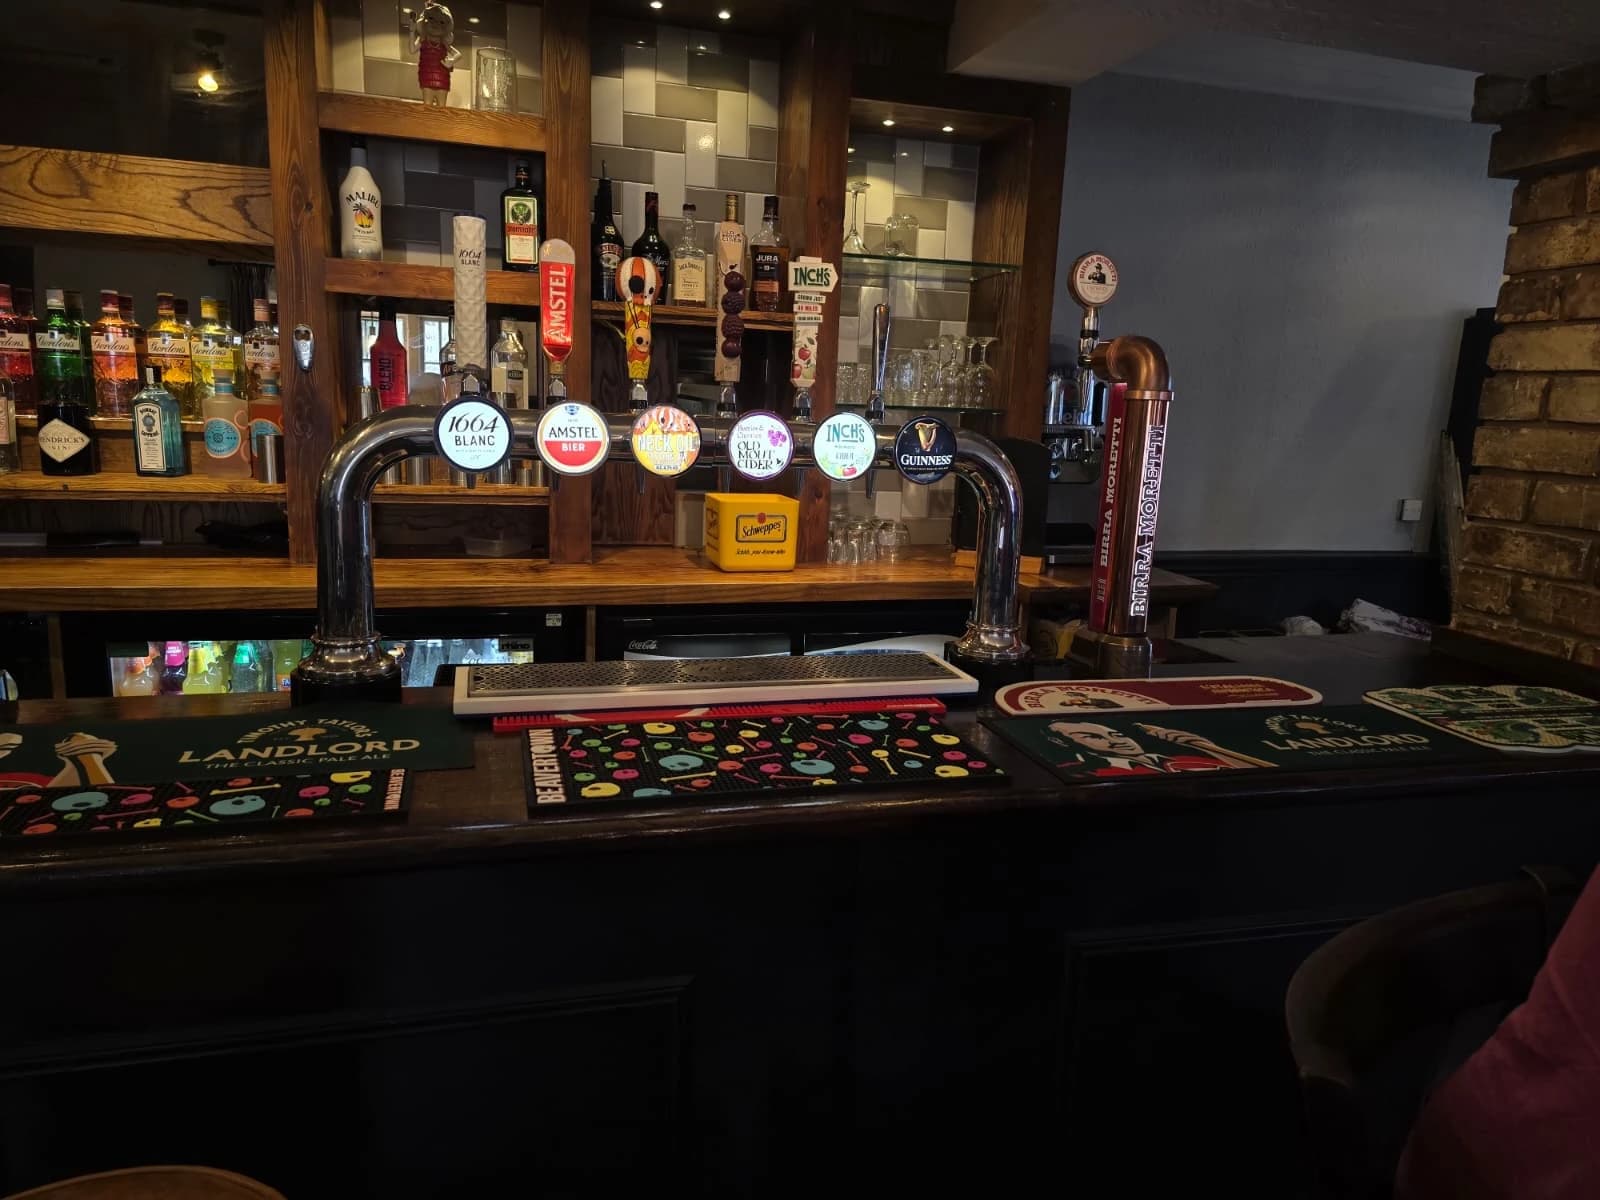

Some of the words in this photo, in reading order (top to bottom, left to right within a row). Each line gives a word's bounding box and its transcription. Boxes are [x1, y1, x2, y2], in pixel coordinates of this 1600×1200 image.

[346, 192, 379, 208] MALIBU
[755, 254, 779, 263] JURA
[794, 266, 831, 286] INCH'S
[547, 265, 568, 343] AMSTEL
[379, 358, 393, 391] BLEND
[448, 412, 500, 433] 1664
[548, 426, 599, 438] AMSTEL
[454, 435, 496, 446] BLANC
[826, 423, 865, 442] INCH'S
[561, 443, 585, 452] BIER
[737, 441, 761, 450] OLD
[737, 459, 773, 470] CIDER
[901, 454, 952, 466] GUINNESS
[1106, 417, 1122, 505] MORETTI
[1138, 424, 1165, 537] MORETTI
[742, 521, 782, 538] Schweppes
[1100, 508, 1113, 567] BIRRA
[1130, 540, 1153, 617] BIRRA
[1024, 689, 1057, 709] BIRRA
[1056, 685, 1161, 705] MORETTI
[236, 719, 307, 744] TIMOTHY
[316, 718, 379, 739] TAYLOR'S
[178, 738, 421, 763] LANDLORD
[1261, 733, 1431, 750] LANDLORD
[242, 757, 313, 769] CLASSIC
[318, 754, 357, 763] PALE
[360, 752, 392, 761] ALE
[528, 728, 568, 804] BEAVERTOWN
